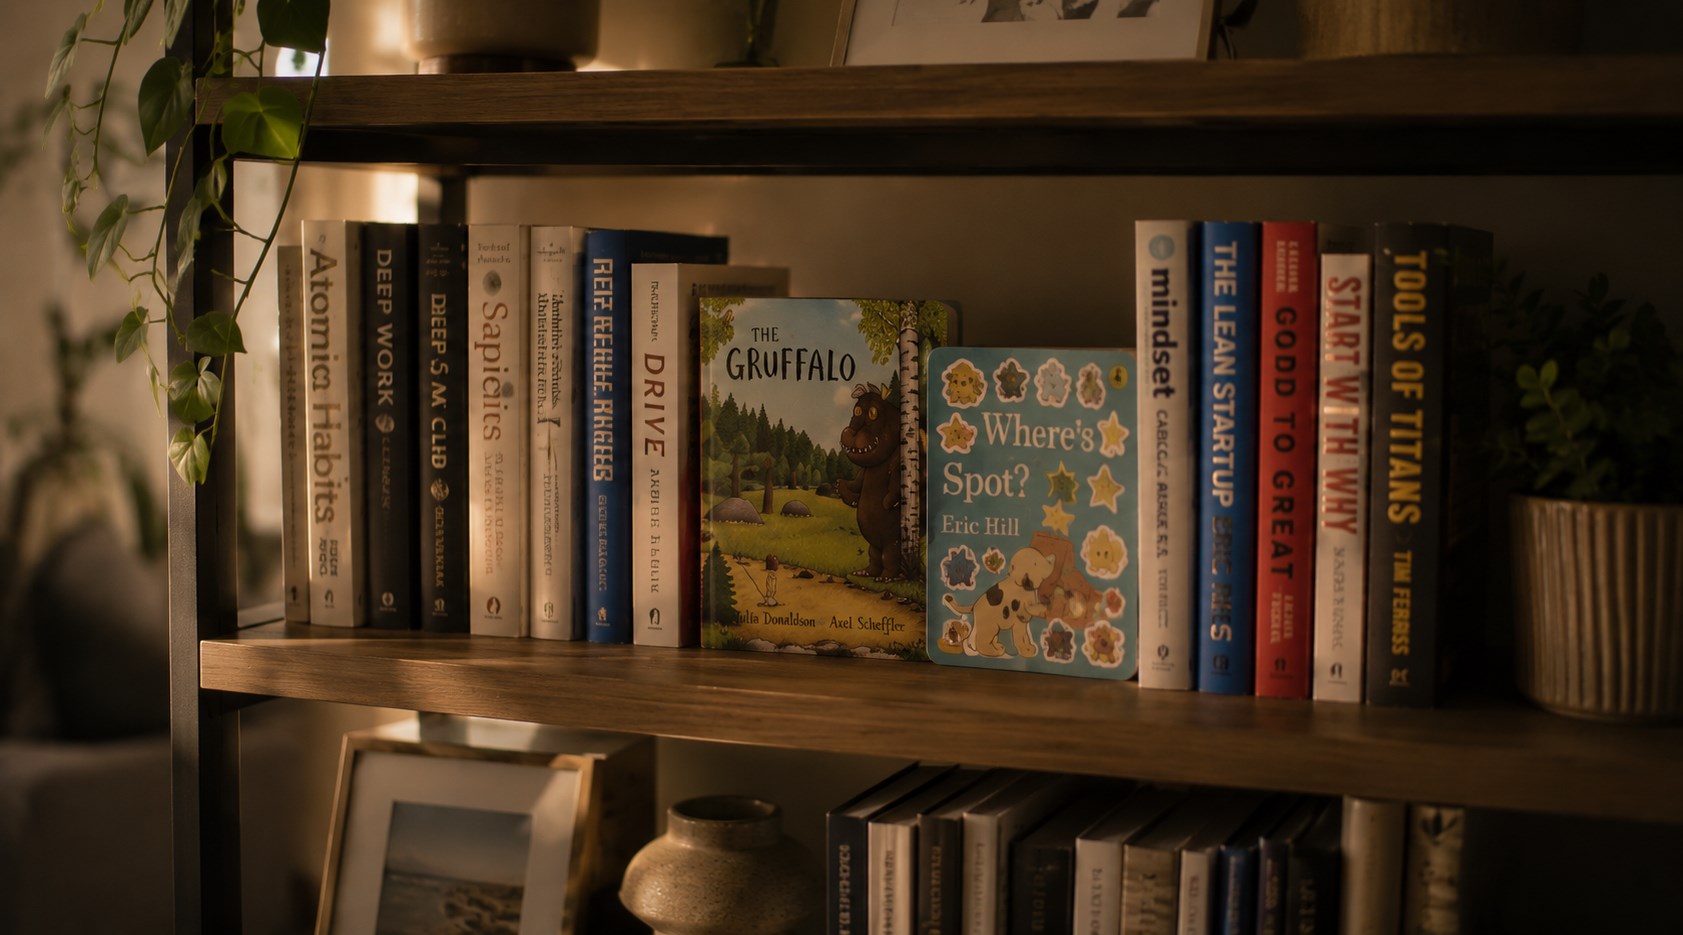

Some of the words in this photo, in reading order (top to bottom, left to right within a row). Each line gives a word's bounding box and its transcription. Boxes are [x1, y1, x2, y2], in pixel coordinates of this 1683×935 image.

[377, 249, 392, 315] DEEP
[1213, 241, 1238, 296] THE
[1391, 250, 1427, 351] TOOLS
[751, 327, 779, 342] THE
[1152, 268, 1178, 398] mindset
[1212, 305, 1237, 375] LEAN
[1325, 277, 1361, 365] START
[377, 323, 394, 406] WORK
[726, 347, 856, 381] GRUFFALO
[1391, 360, 1425, 399] OF
[645, 353, 665, 457] DRIVE
[981, 412, 1095, 453] Where's
[1273, 412, 1295, 453] TO
[1322, 376, 1359, 455] WITH
[313, 403, 347, 524] Habits
[1211, 382, 1236, 507] STARTUP
[1387, 408, 1424, 525] TITANS
[943, 462, 1030, 503] Spot?
[1321, 468, 1358, 535] WHY
[941, 514, 980, 534] Eric
[984, 517, 1020, 536] Hill
[1270, 471, 1295, 580] GREAT
[763, 611, 816, 628] Donaldson
[829, 615, 853, 629] Axel
[857, 616, 905, 636] Scheffler
